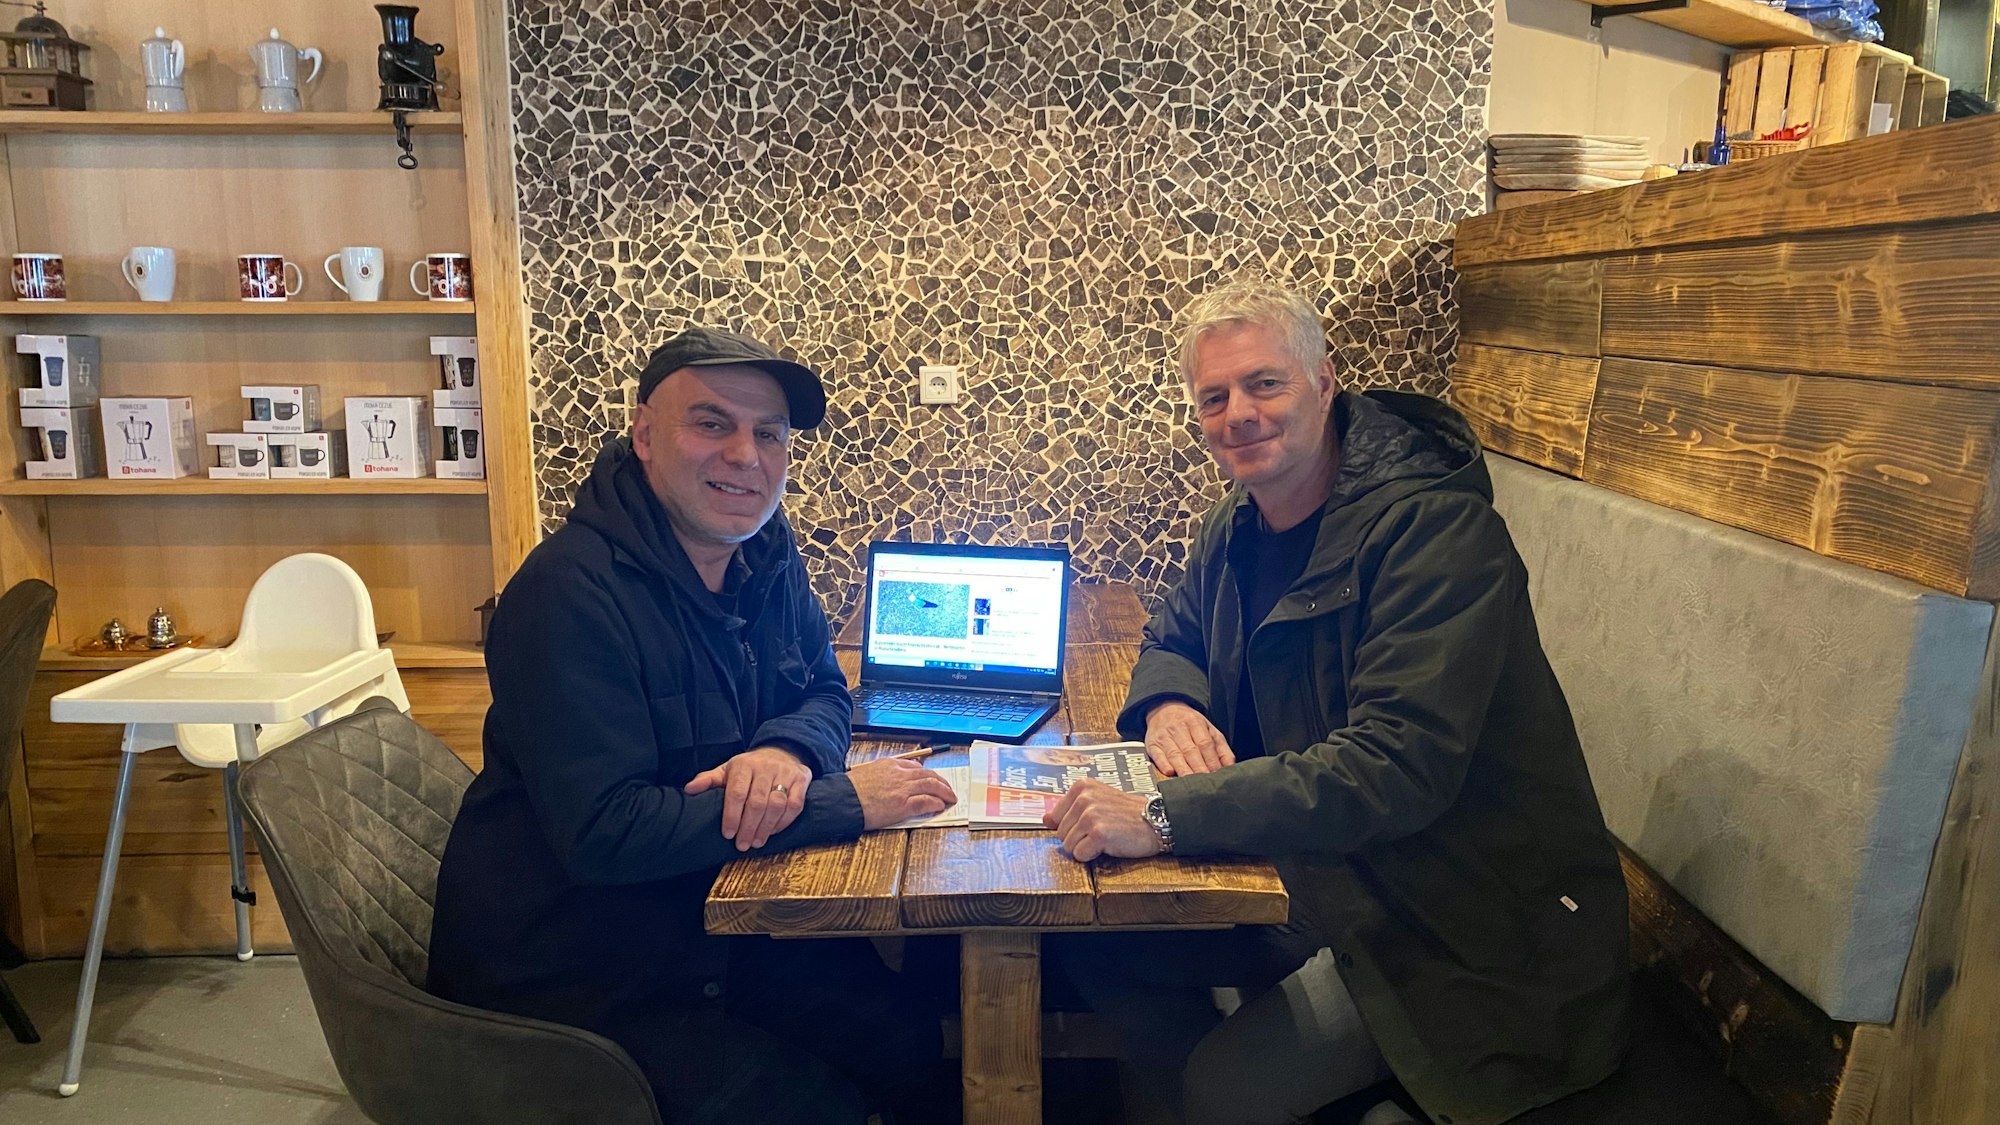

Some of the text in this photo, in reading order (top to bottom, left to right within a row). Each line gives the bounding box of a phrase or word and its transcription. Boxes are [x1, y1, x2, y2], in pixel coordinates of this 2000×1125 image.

[131, 466, 157, 474] tohana
[373, 465, 399, 473] tohana
[1000, 766, 1027, 789] Boris:
